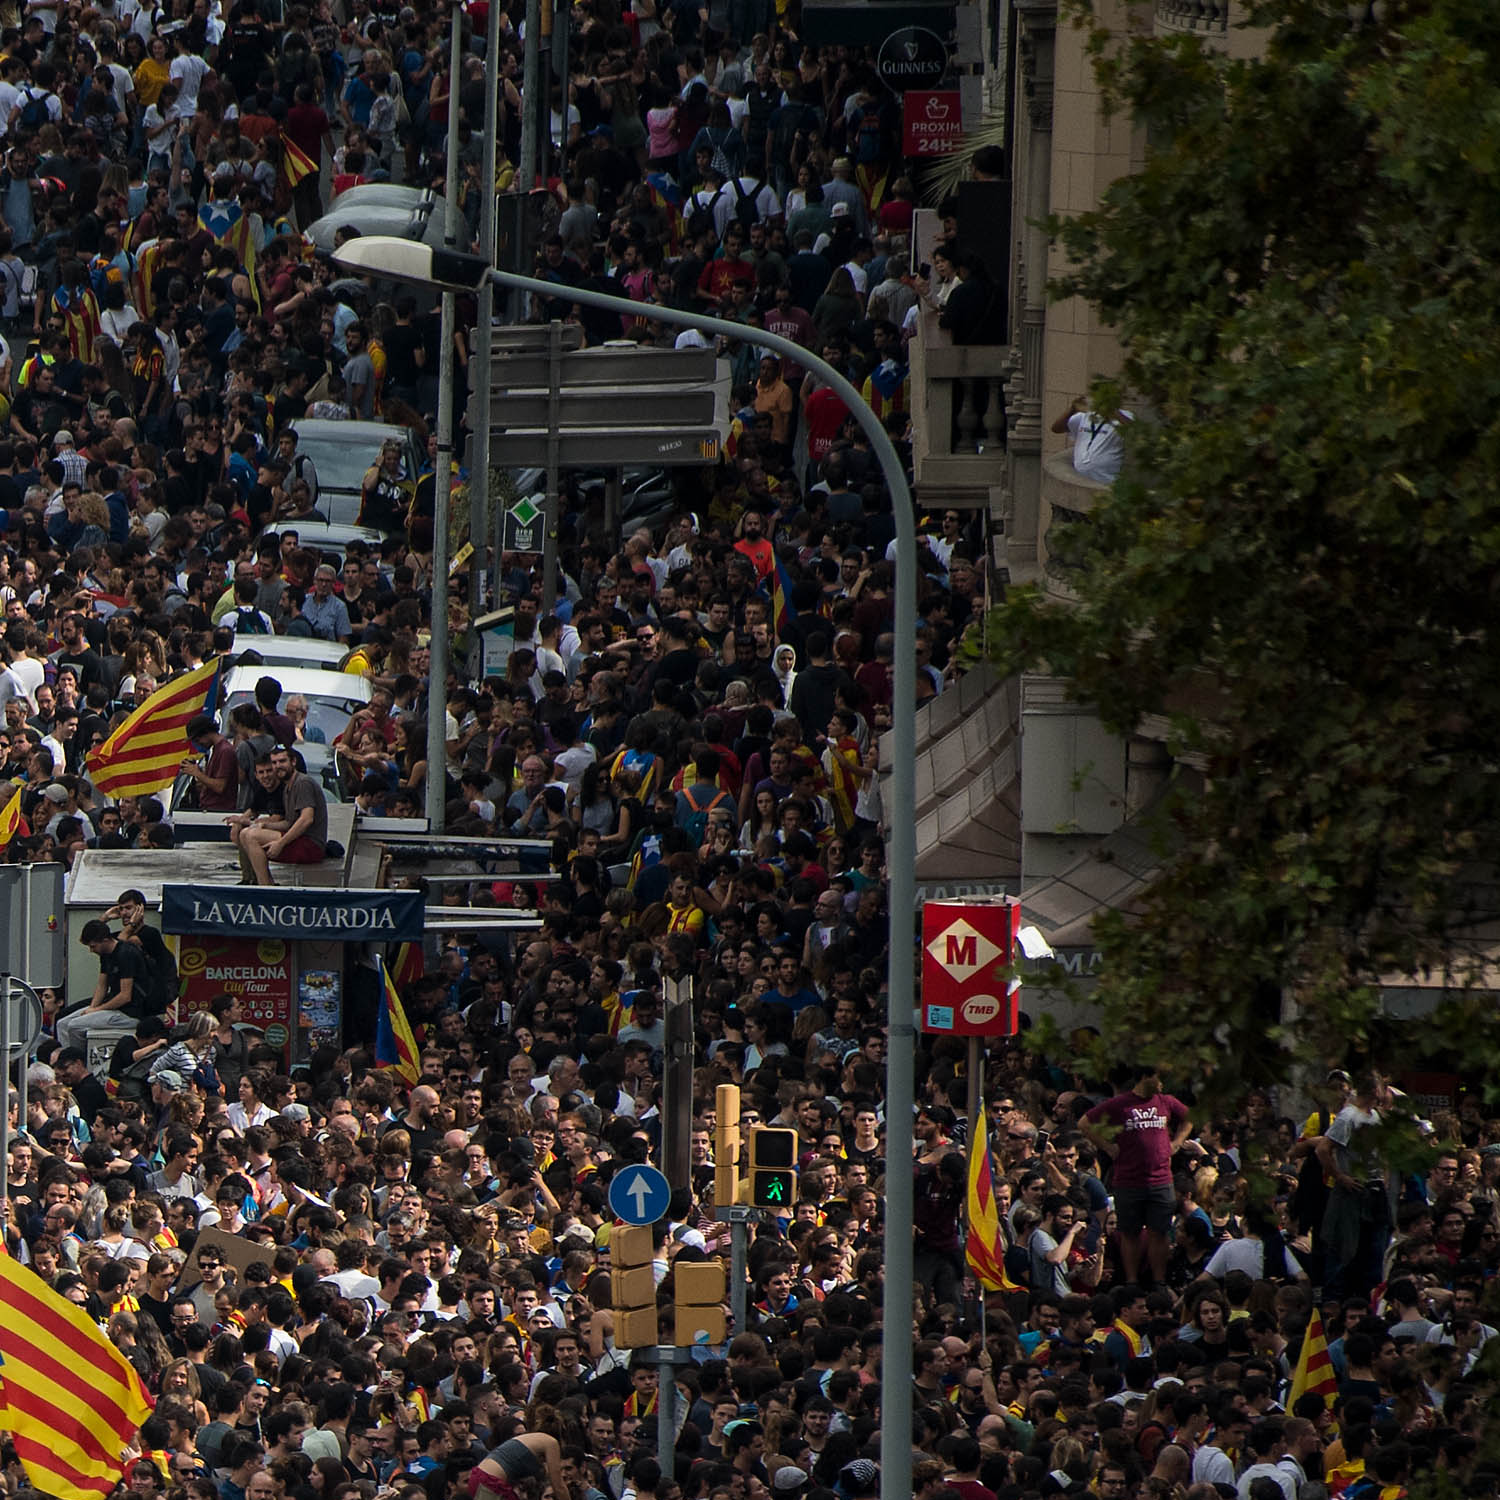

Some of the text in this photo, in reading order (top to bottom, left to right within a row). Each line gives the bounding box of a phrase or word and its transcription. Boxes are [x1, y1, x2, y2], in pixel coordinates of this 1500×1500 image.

[882, 59, 942, 75] GUINNESS
[918, 138, 953, 153] 24H
[193, 901, 396, 928] LA VANGUARDIA
[945, 935, 977, 966] M
[205, 966, 288, 980] BARCELONA
[245, 981, 270, 993] Tour
[968, 1004, 995, 1015] TMB
